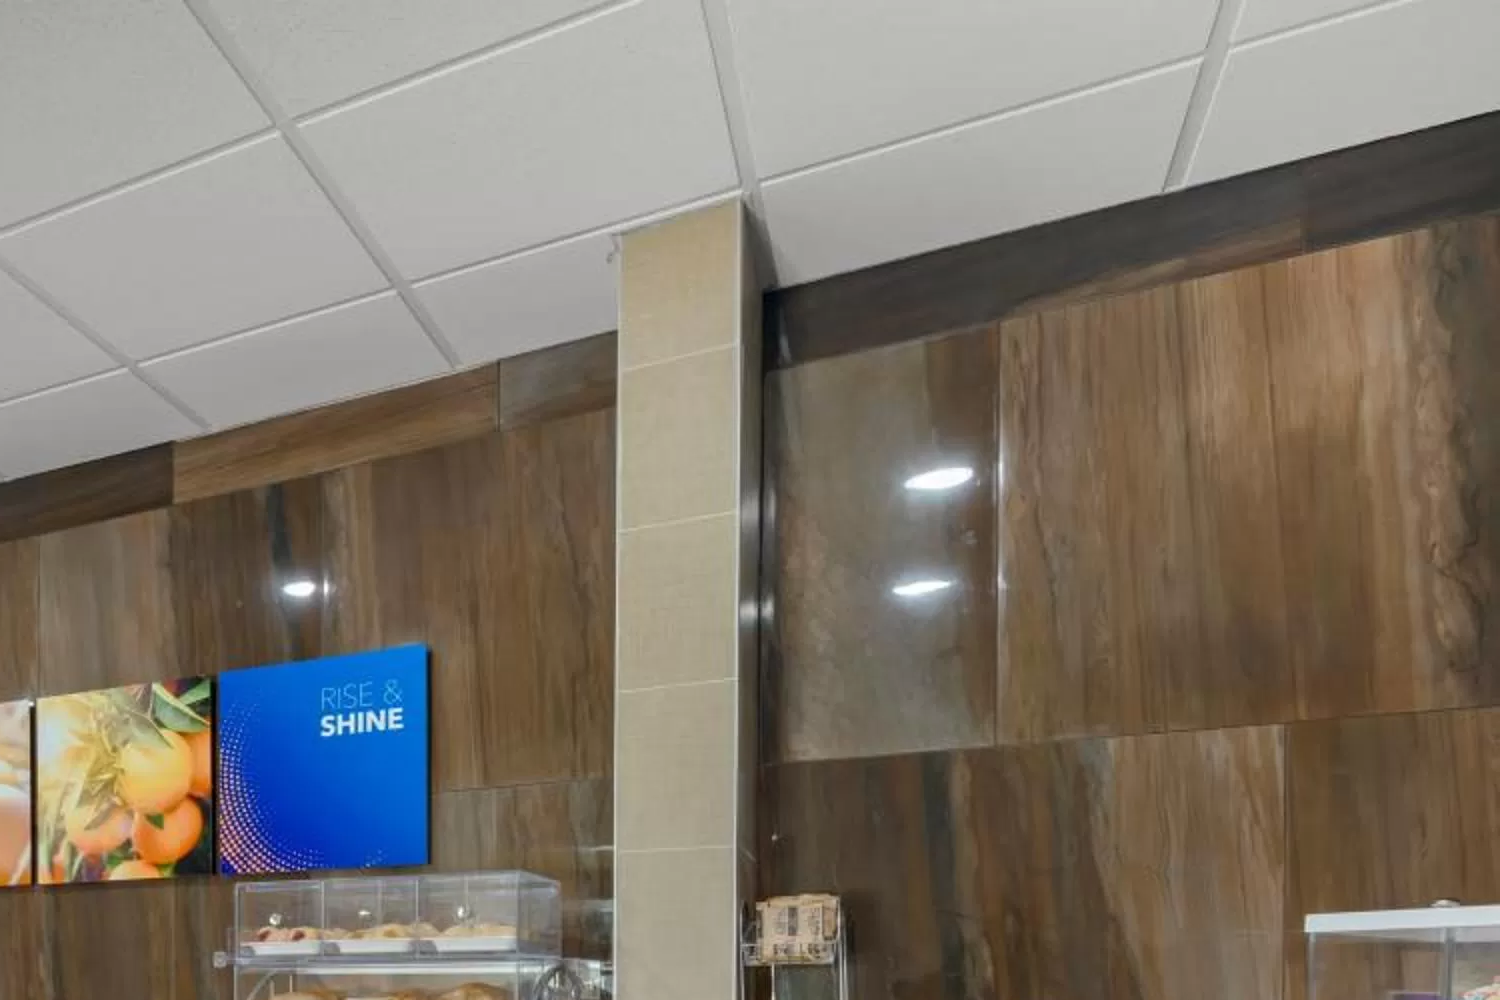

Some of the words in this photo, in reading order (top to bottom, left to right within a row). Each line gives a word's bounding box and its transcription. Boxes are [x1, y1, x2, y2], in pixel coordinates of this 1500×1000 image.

[321, 681, 373, 711] RISE
[383, 679, 403, 705] &
[320, 707, 404, 737] SHINE
